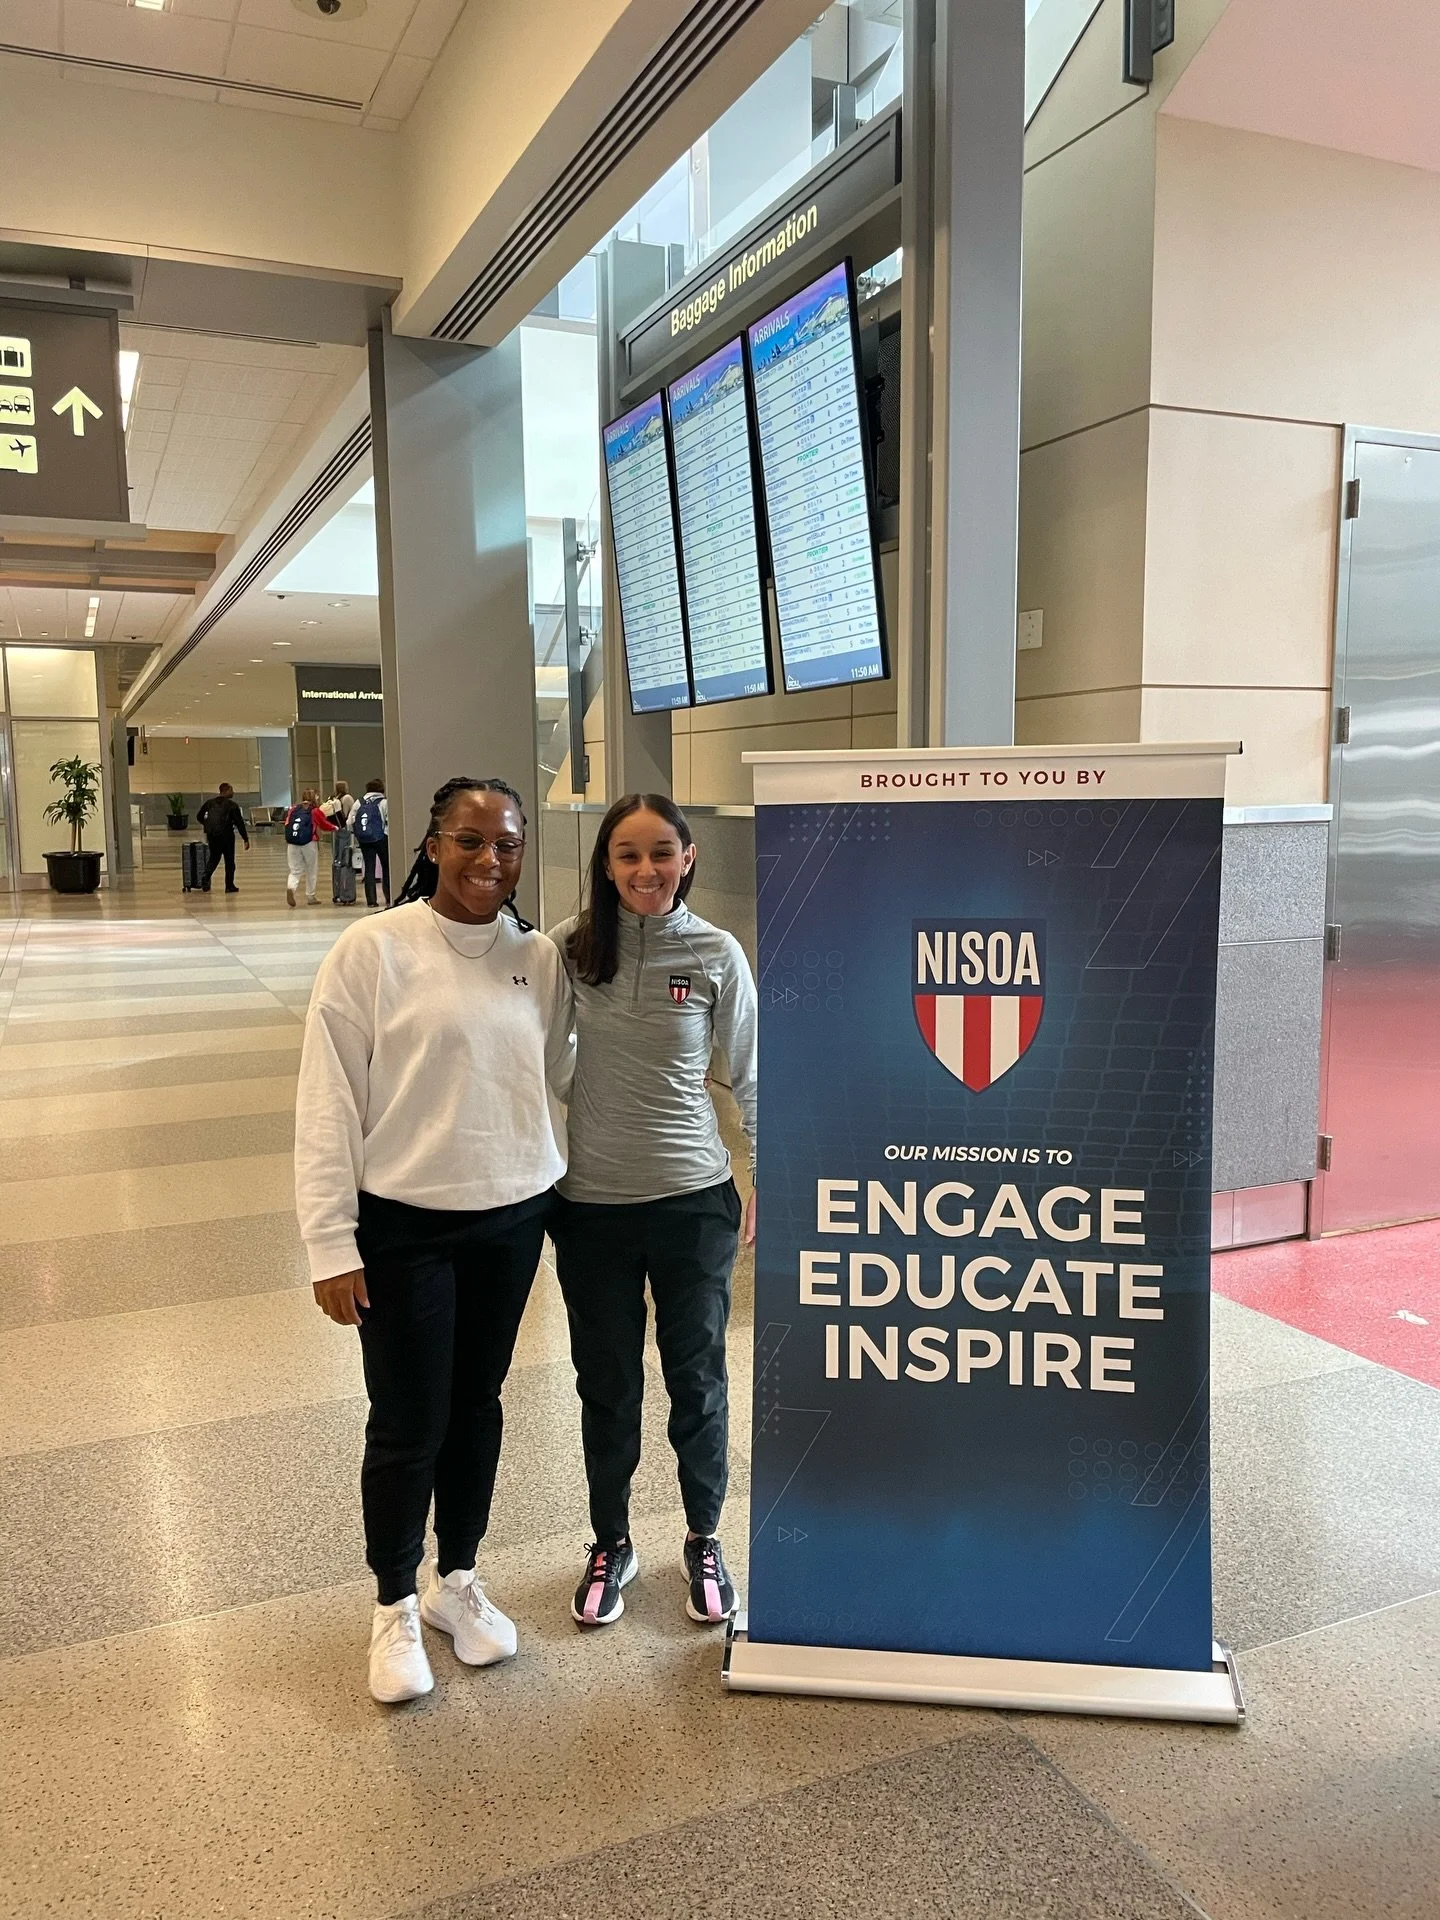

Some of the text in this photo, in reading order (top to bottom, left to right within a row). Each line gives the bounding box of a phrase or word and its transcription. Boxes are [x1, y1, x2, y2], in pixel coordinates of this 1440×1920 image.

[672, 204, 818, 336] Baggage Information
[754, 311, 790, 346] ARRIVALS
[792, 350, 808, 363] DELTA
[794, 366, 809, 379] DELTA
[673, 374, 700, 402] ARRIVALS
[797, 400, 812, 412] DELTA
[800, 433, 816, 444] DELTA
[796, 448, 819, 463] FRONTIER
[851, 664, 879, 679] 11:50 AM
[302, 690, 356, 699] International
[860, 770, 1106, 788] BROUGHT TO YOU BY
[917, 931, 1040, 986] NISOA
[884, 1144, 1073, 1165] OUR MISSION IS TO
[817, 1178, 1146, 1246] ENGAGE
[799, 1250, 1164, 1320] EDUCATE
[825, 1324, 1135, 1393] INSPIRE
